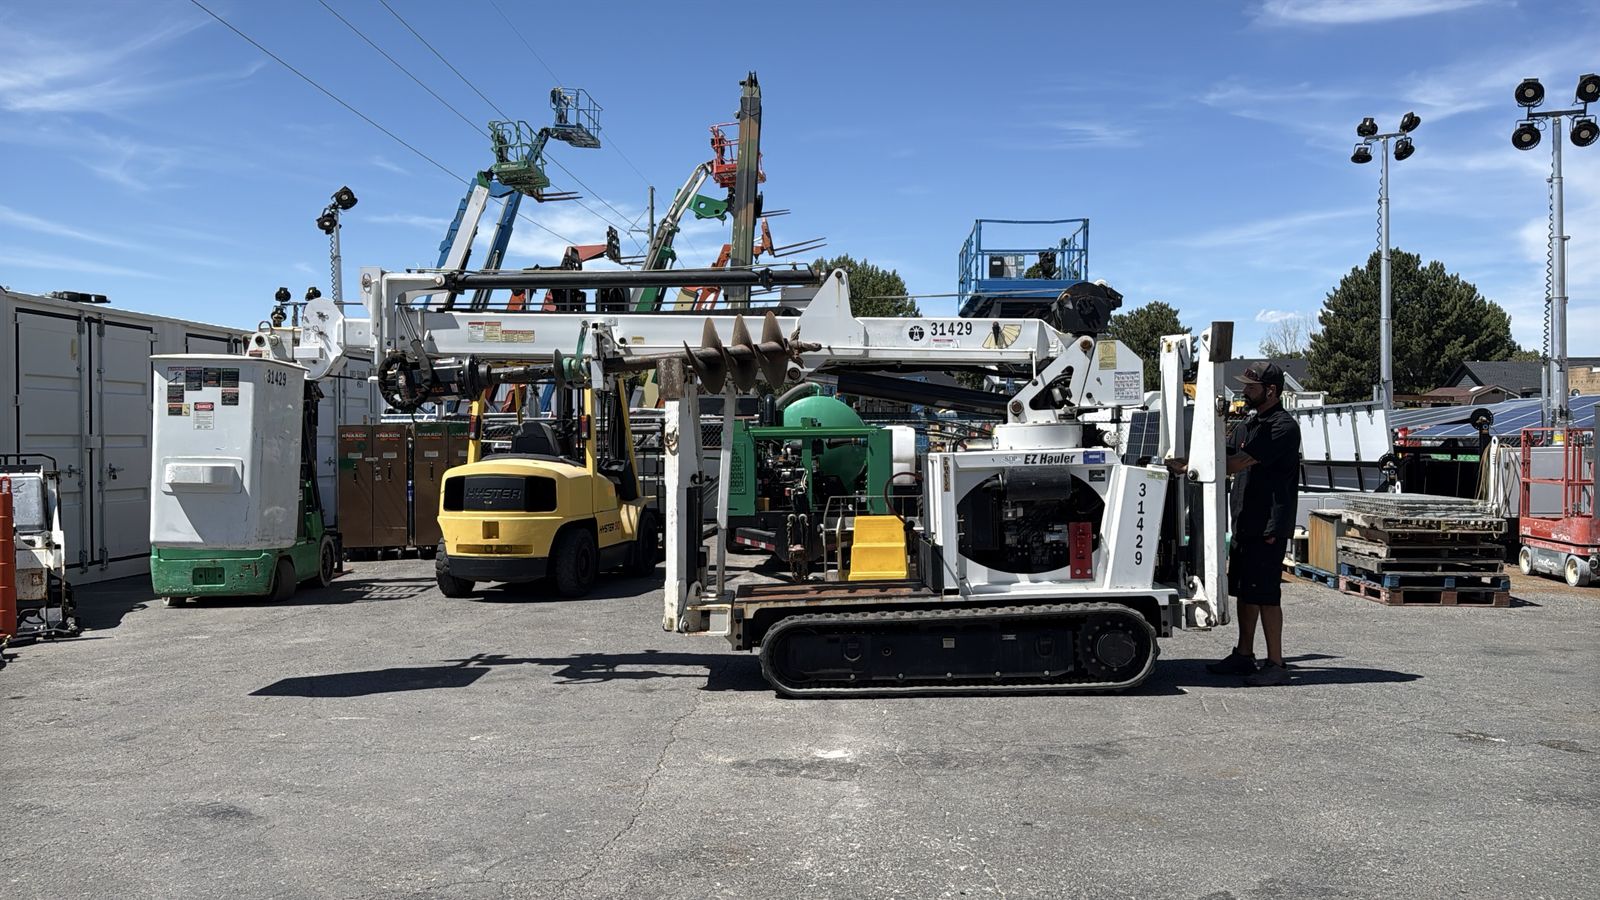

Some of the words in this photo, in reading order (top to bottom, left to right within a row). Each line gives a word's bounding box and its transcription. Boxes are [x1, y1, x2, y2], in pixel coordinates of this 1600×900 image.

[930, 321, 973, 336] 31429
[266, 369, 287, 387] 31429
[1024, 454, 1038, 465] EZ
[1039, 452, 1076, 465] Hauler
[465, 487, 522, 499] HYSTER
[598, 522, 615, 534] HYSTER
[1134, 482, 1147, 566] 31429
